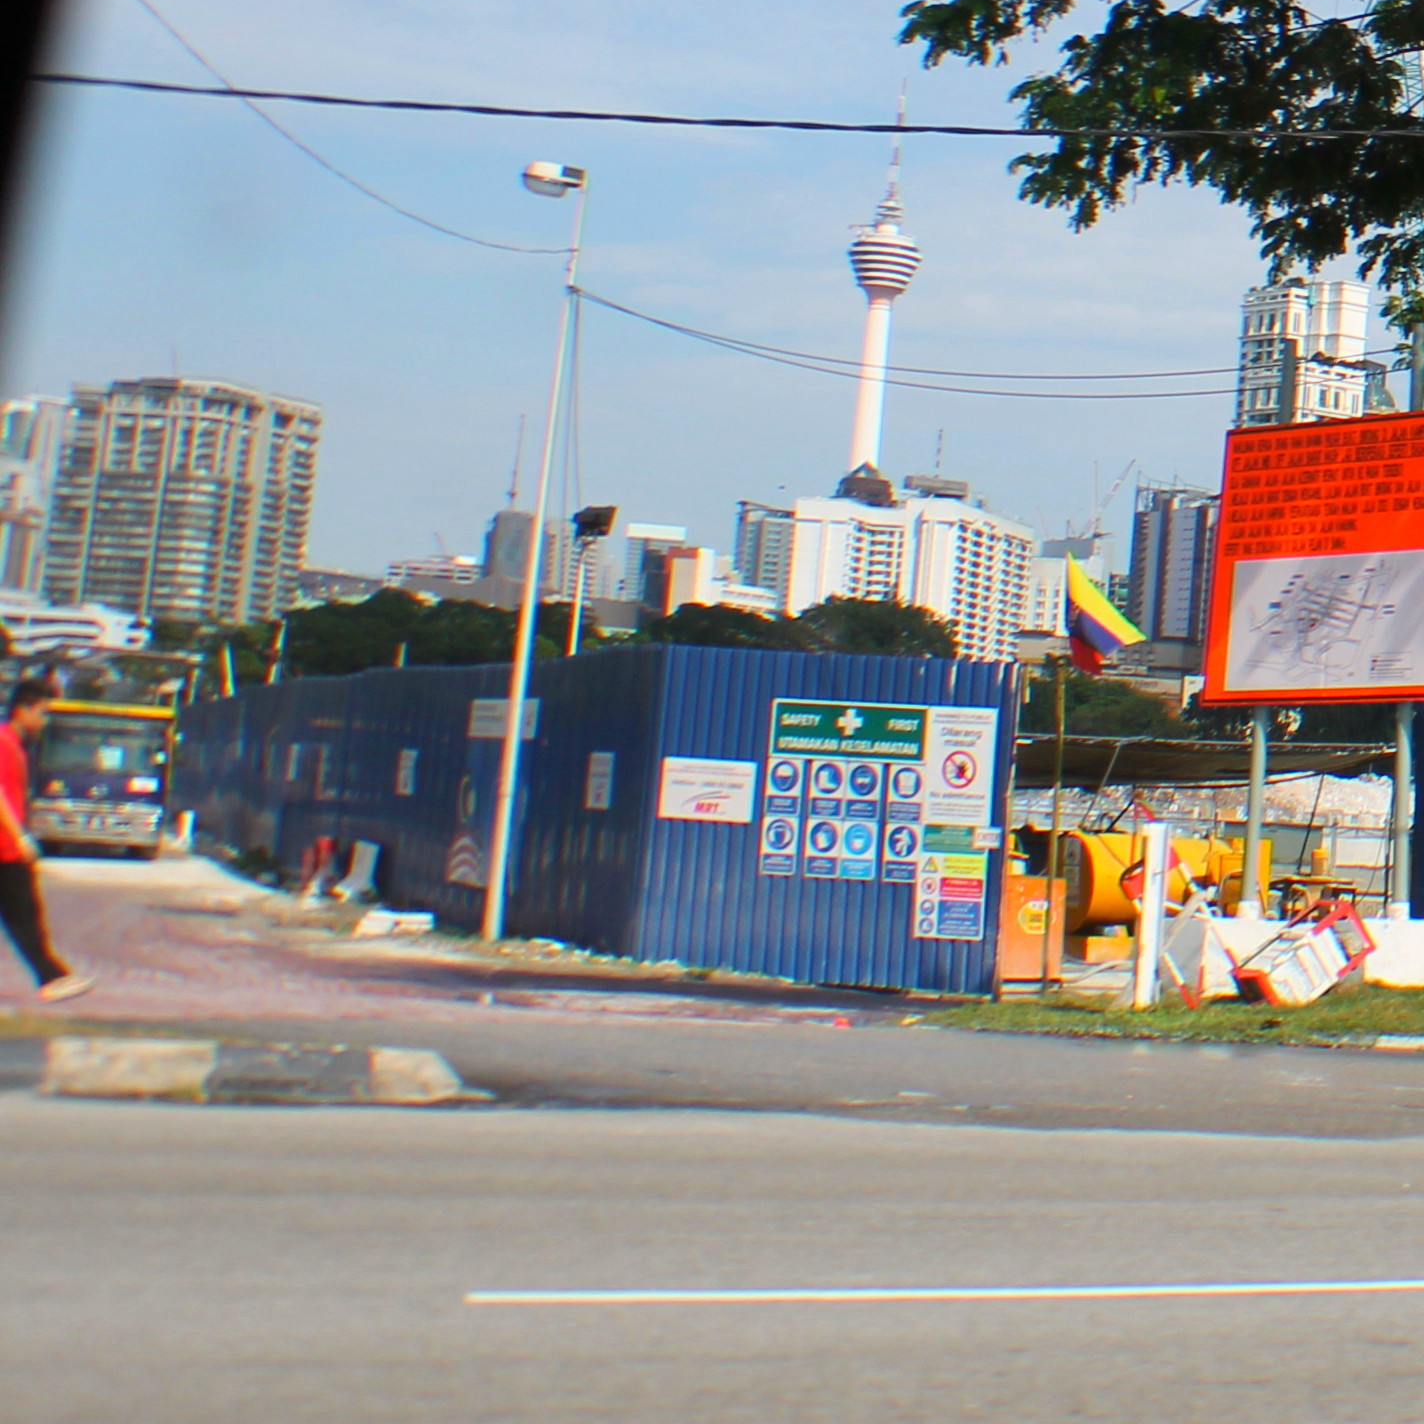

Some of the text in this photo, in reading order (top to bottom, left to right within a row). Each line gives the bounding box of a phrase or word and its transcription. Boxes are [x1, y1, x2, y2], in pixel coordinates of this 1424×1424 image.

[781, 713, 821, 727] SAFETY
[887, 718, 920, 732] FIRST
[778, 736, 920, 756] UTAMAKAN KESELAMATAN
[694, 802, 720, 813] MRT
